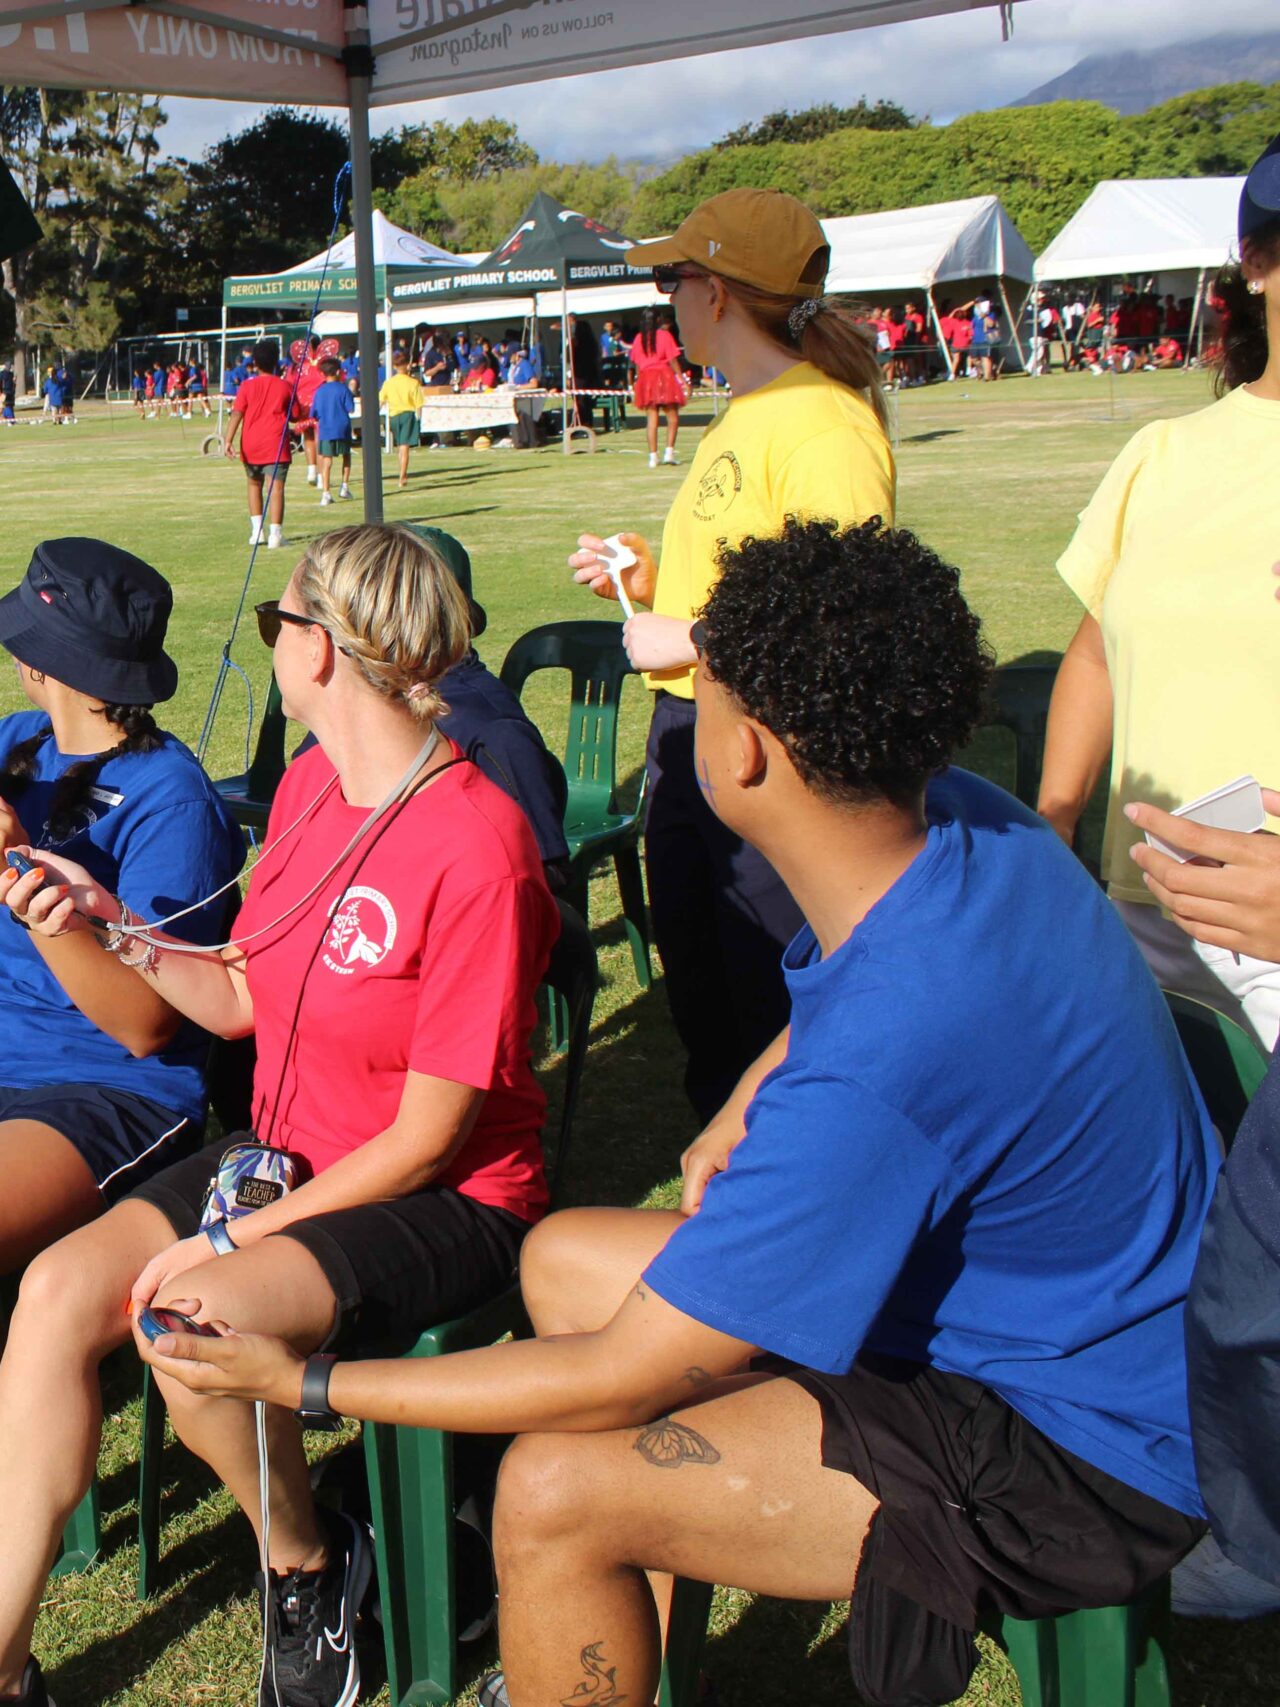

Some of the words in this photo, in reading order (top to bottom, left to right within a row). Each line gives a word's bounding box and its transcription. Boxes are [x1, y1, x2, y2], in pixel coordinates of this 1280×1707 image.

[569, 264, 625, 279] BERGVLIET
[230, 282, 283, 297] BERGVLIET
[289, 279, 332, 292] PRIMARY
[338, 278, 357, 290] SCH
[393, 277, 451, 297] BERGVLIET
[453, 271, 505, 288] PRIMARY
[507, 268, 557, 284] SCHOOL
[243, 1186, 276, 1202] TEACHER
